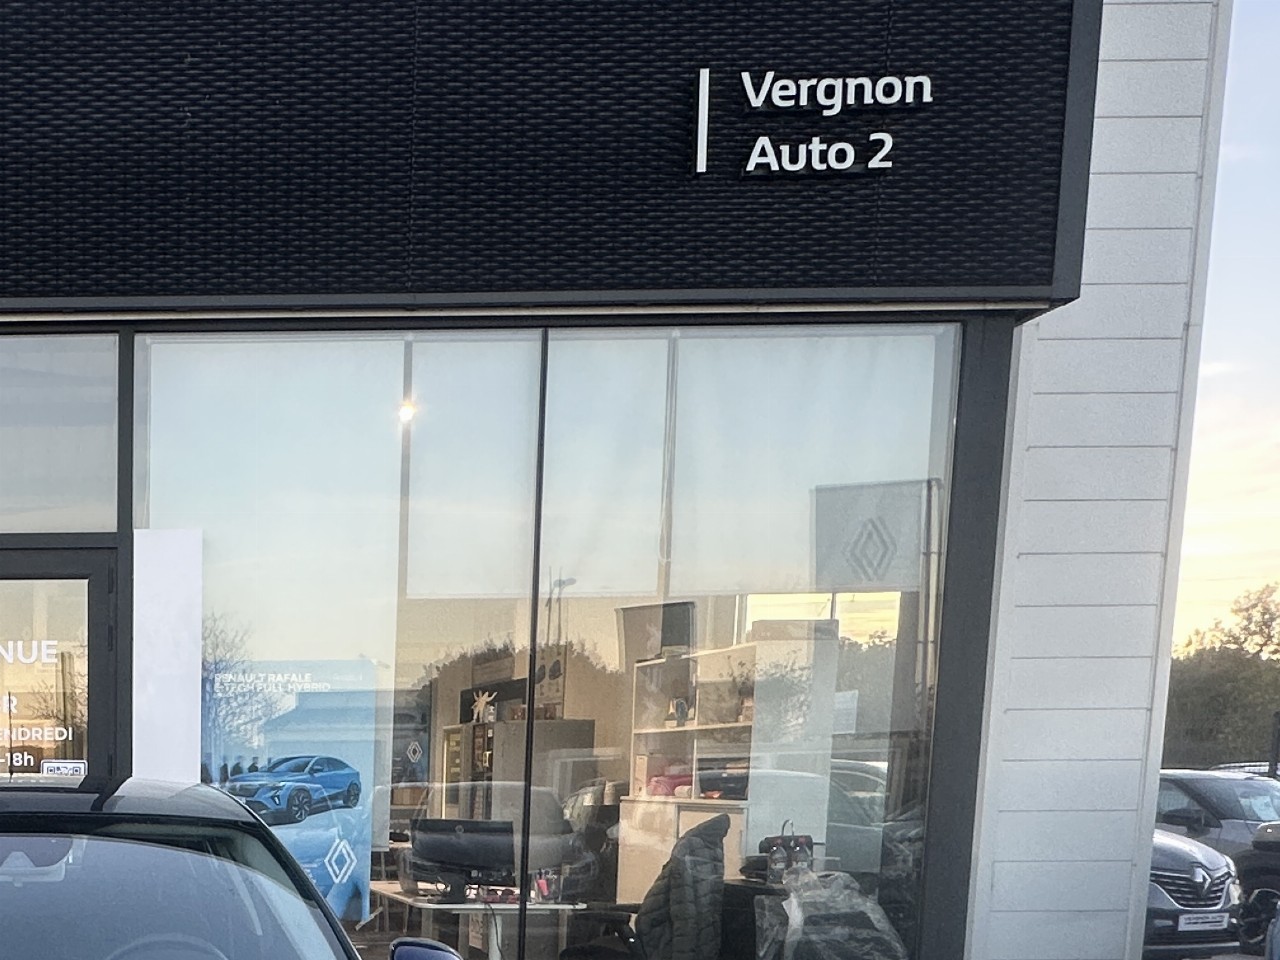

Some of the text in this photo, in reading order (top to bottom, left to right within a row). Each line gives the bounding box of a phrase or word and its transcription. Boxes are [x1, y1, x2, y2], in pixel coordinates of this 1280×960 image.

[741, 71, 933, 116] Vergnon
[746, 132, 893, 172] Auto 2
[268, 673, 313, 683] RAFALE
[287, 682, 331, 692] HYBRID
